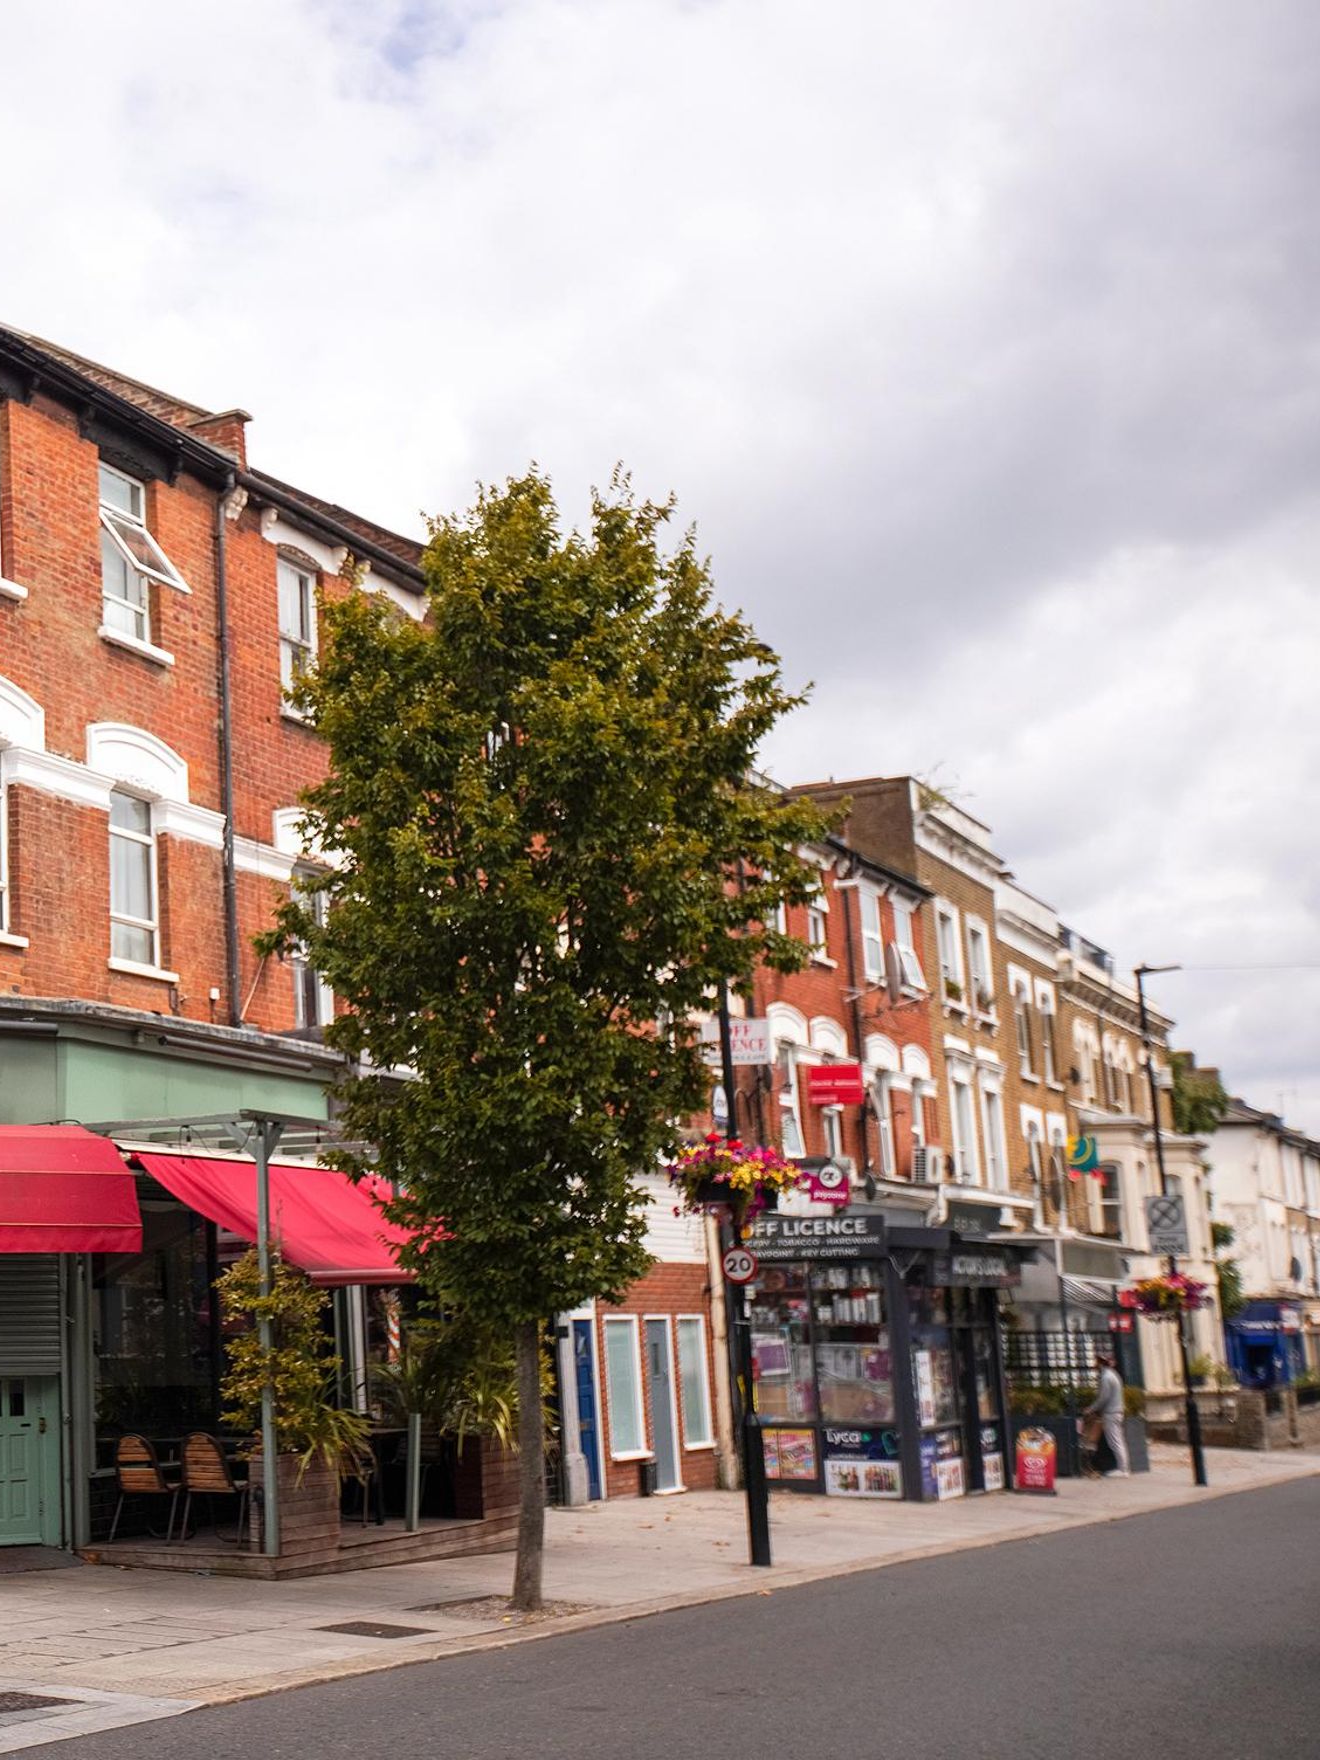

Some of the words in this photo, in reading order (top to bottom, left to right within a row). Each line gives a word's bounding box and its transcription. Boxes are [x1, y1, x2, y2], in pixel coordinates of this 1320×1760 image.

[783, 1218, 867, 1237] LICENCE
[777, 1238, 819, 1247] TOBACCO
[820, 1248, 859, 1258] CUTTING
[726, 1258, 751, 1273] 20
